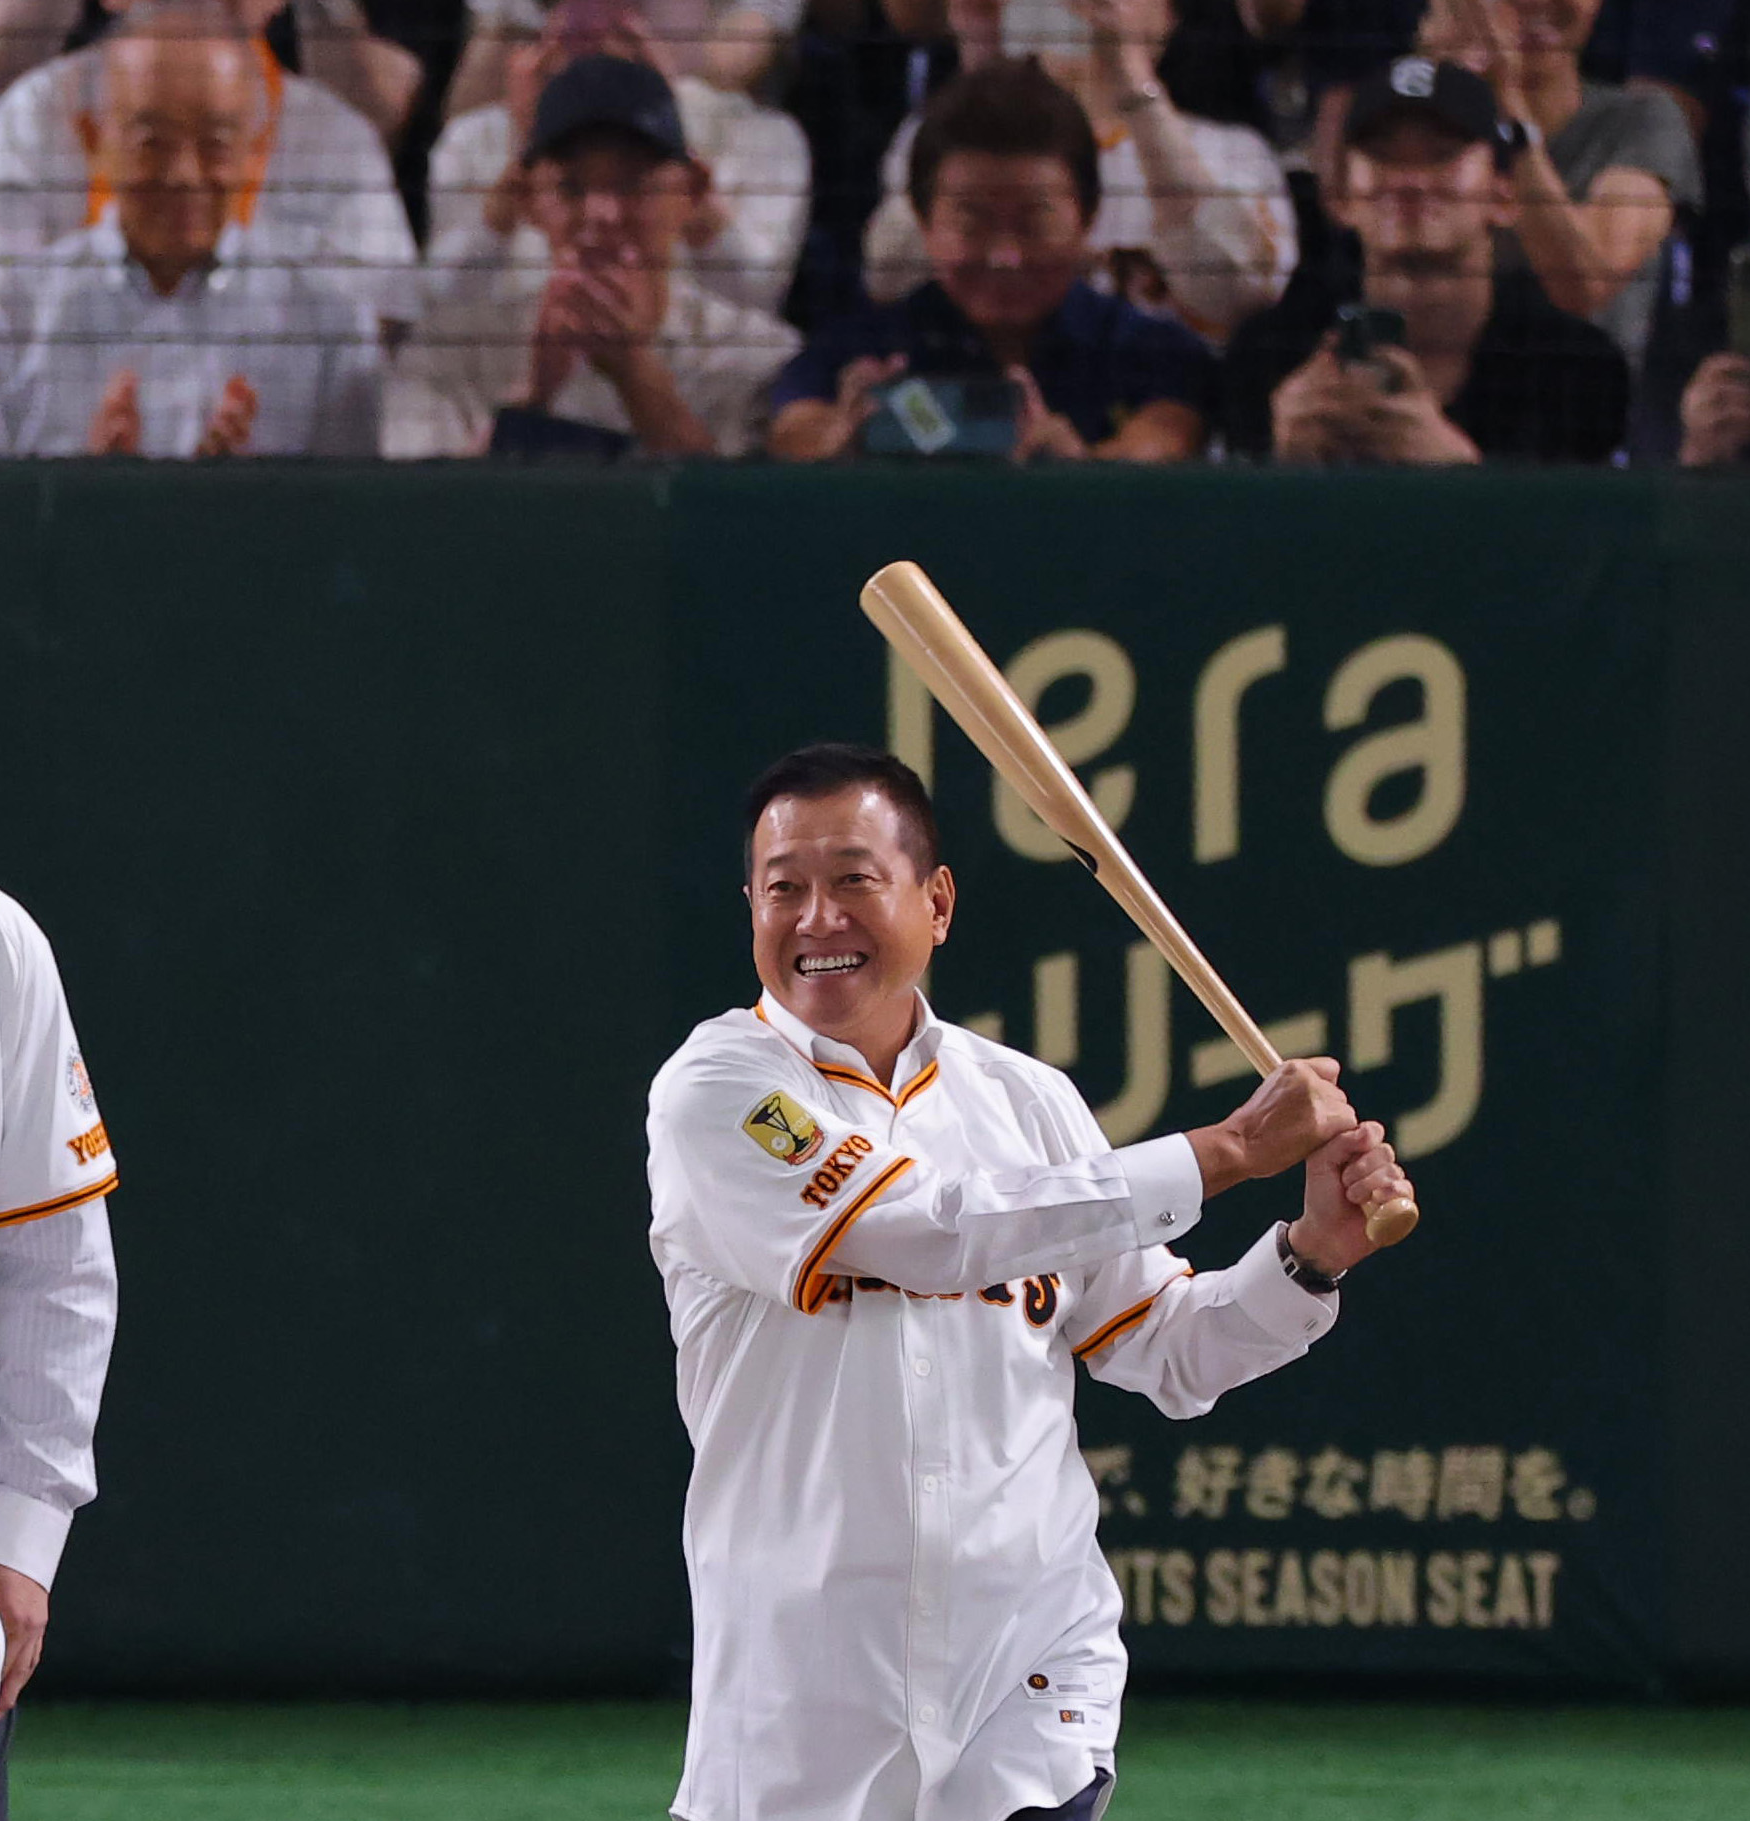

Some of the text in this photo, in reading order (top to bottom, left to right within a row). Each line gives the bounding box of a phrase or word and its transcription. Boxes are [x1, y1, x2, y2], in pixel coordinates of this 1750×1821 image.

[962, 920, 1561, 1162] リーグ
[800, 1135, 874, 1210] TOKYO
[1205, 1550, 1417, 1628] SEASON
[1426, 1551, 1560, 1629] SEAT
